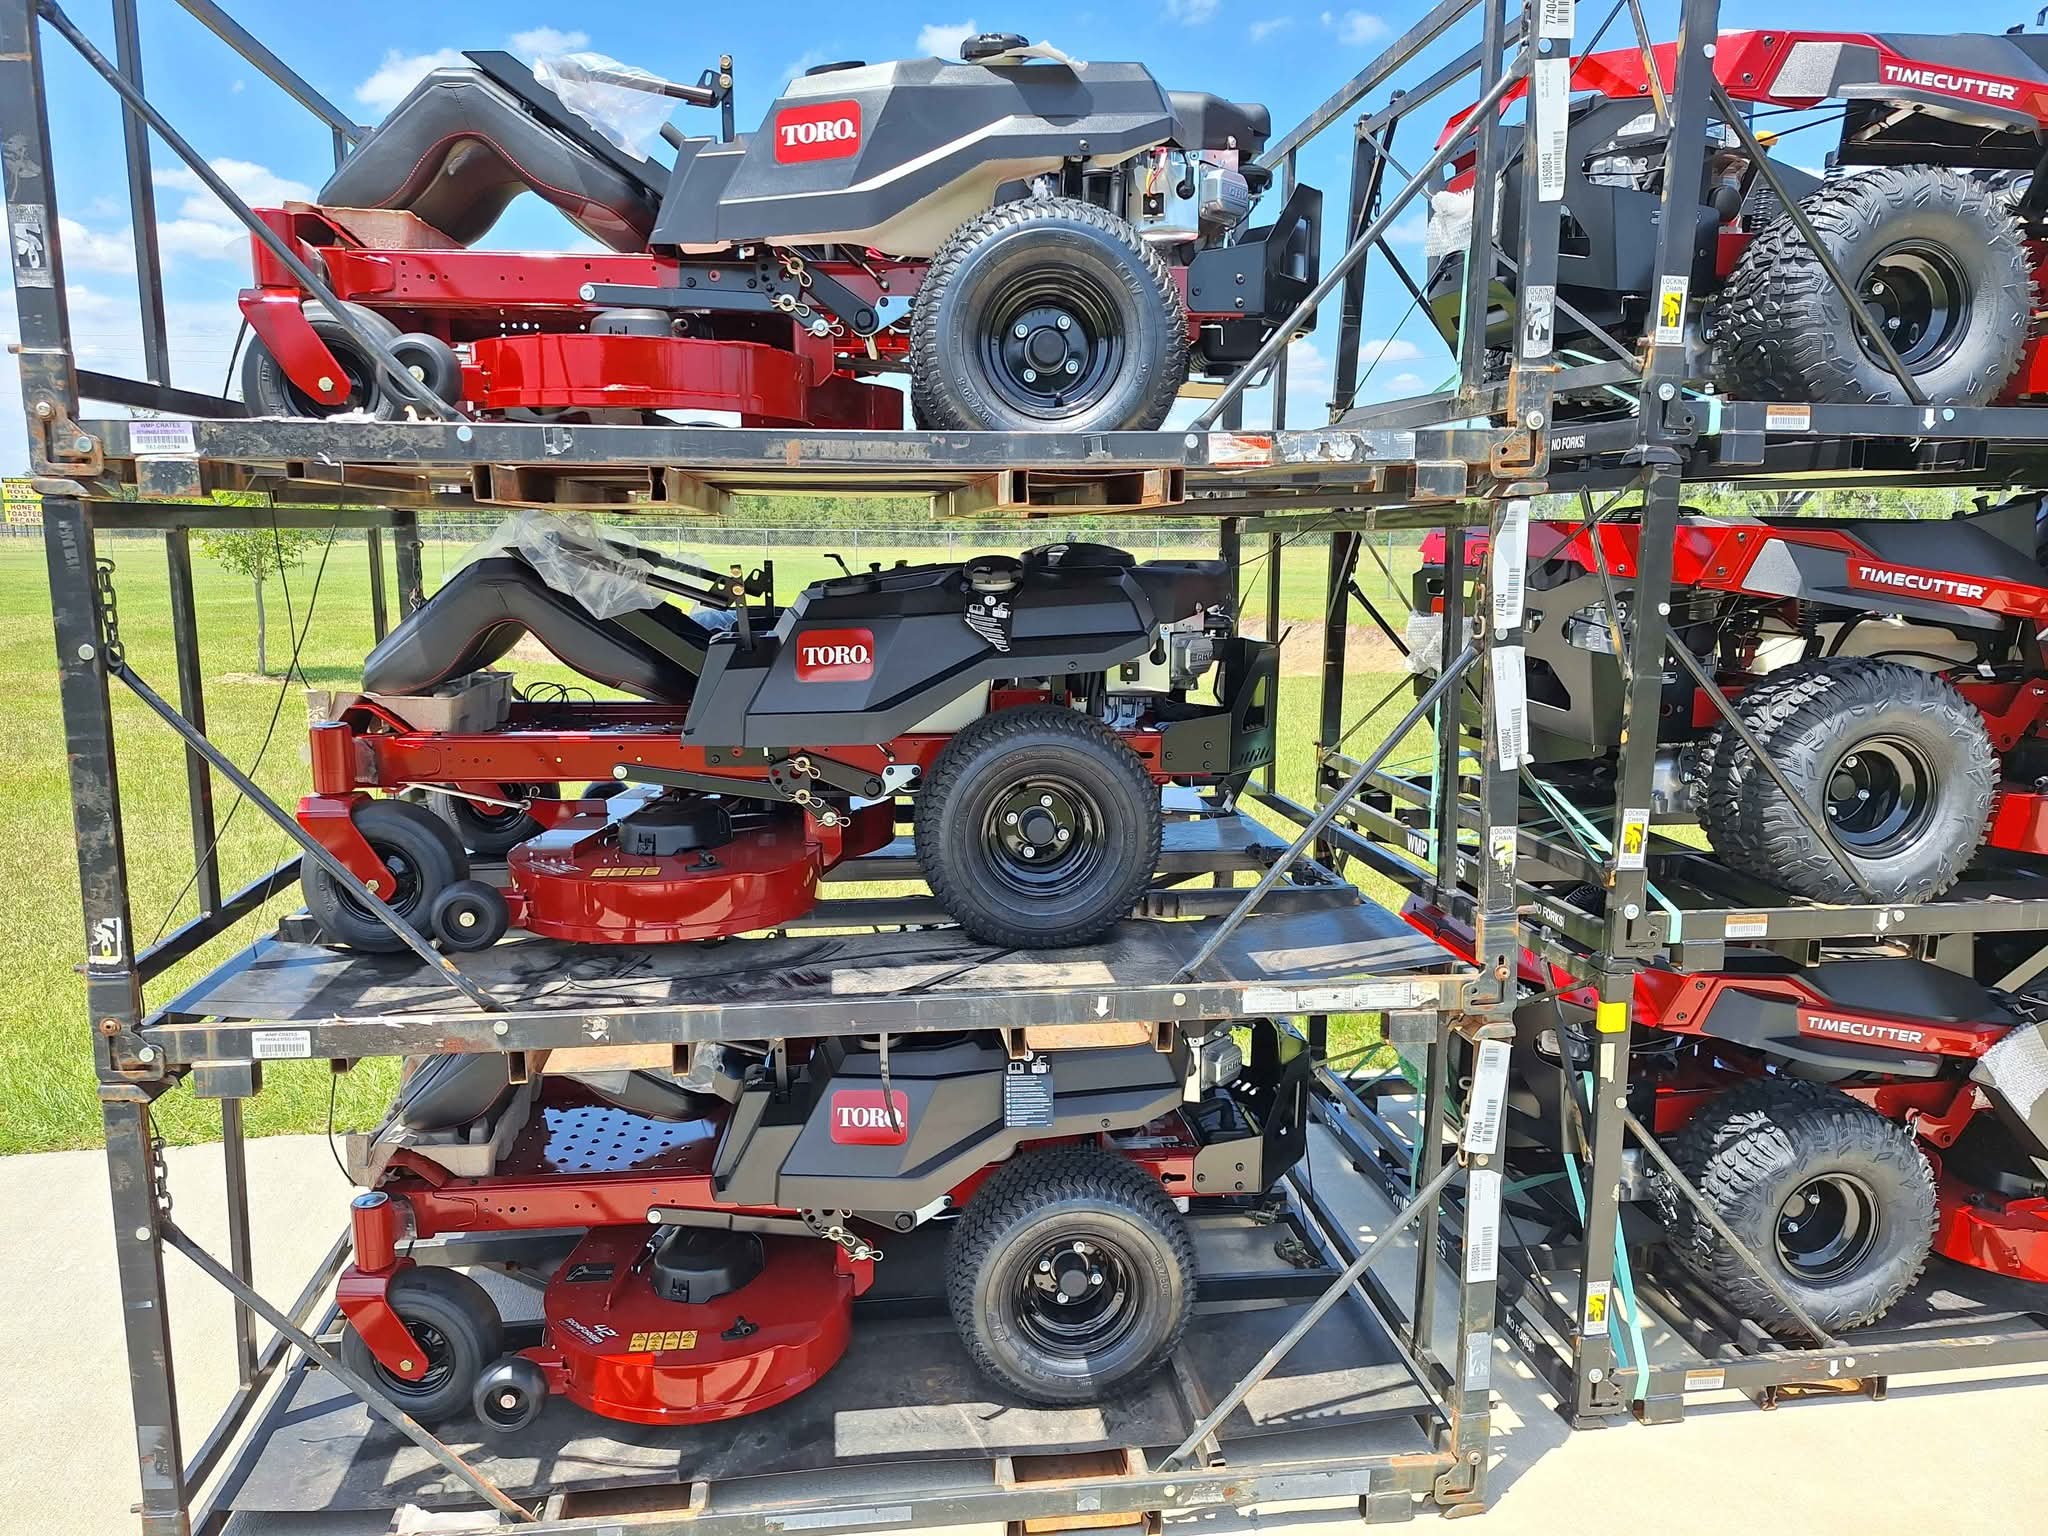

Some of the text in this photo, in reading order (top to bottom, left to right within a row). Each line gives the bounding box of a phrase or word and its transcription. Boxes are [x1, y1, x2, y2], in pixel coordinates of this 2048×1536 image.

[1885, 65, 2016, 100] TIMECUTTER
[781, 118, 854, 146] TORO
[1663, 278, 1687, 286] LOCKING
[1551, 435, 1584, 451] NO FORKS
[1859, 566, 1984, 599] TIMECUTTER
[803, 645, 868, 667] TORO
[1407, 832, 1428, 858] WMP
[1543, 906, 1564, 928] FORKS
[1808, 1016, 1921, 1043] TIMECUTTER
[837, 1107, 902, 1128] TORO
[1471, 1121, 1484, 1143] 77404
